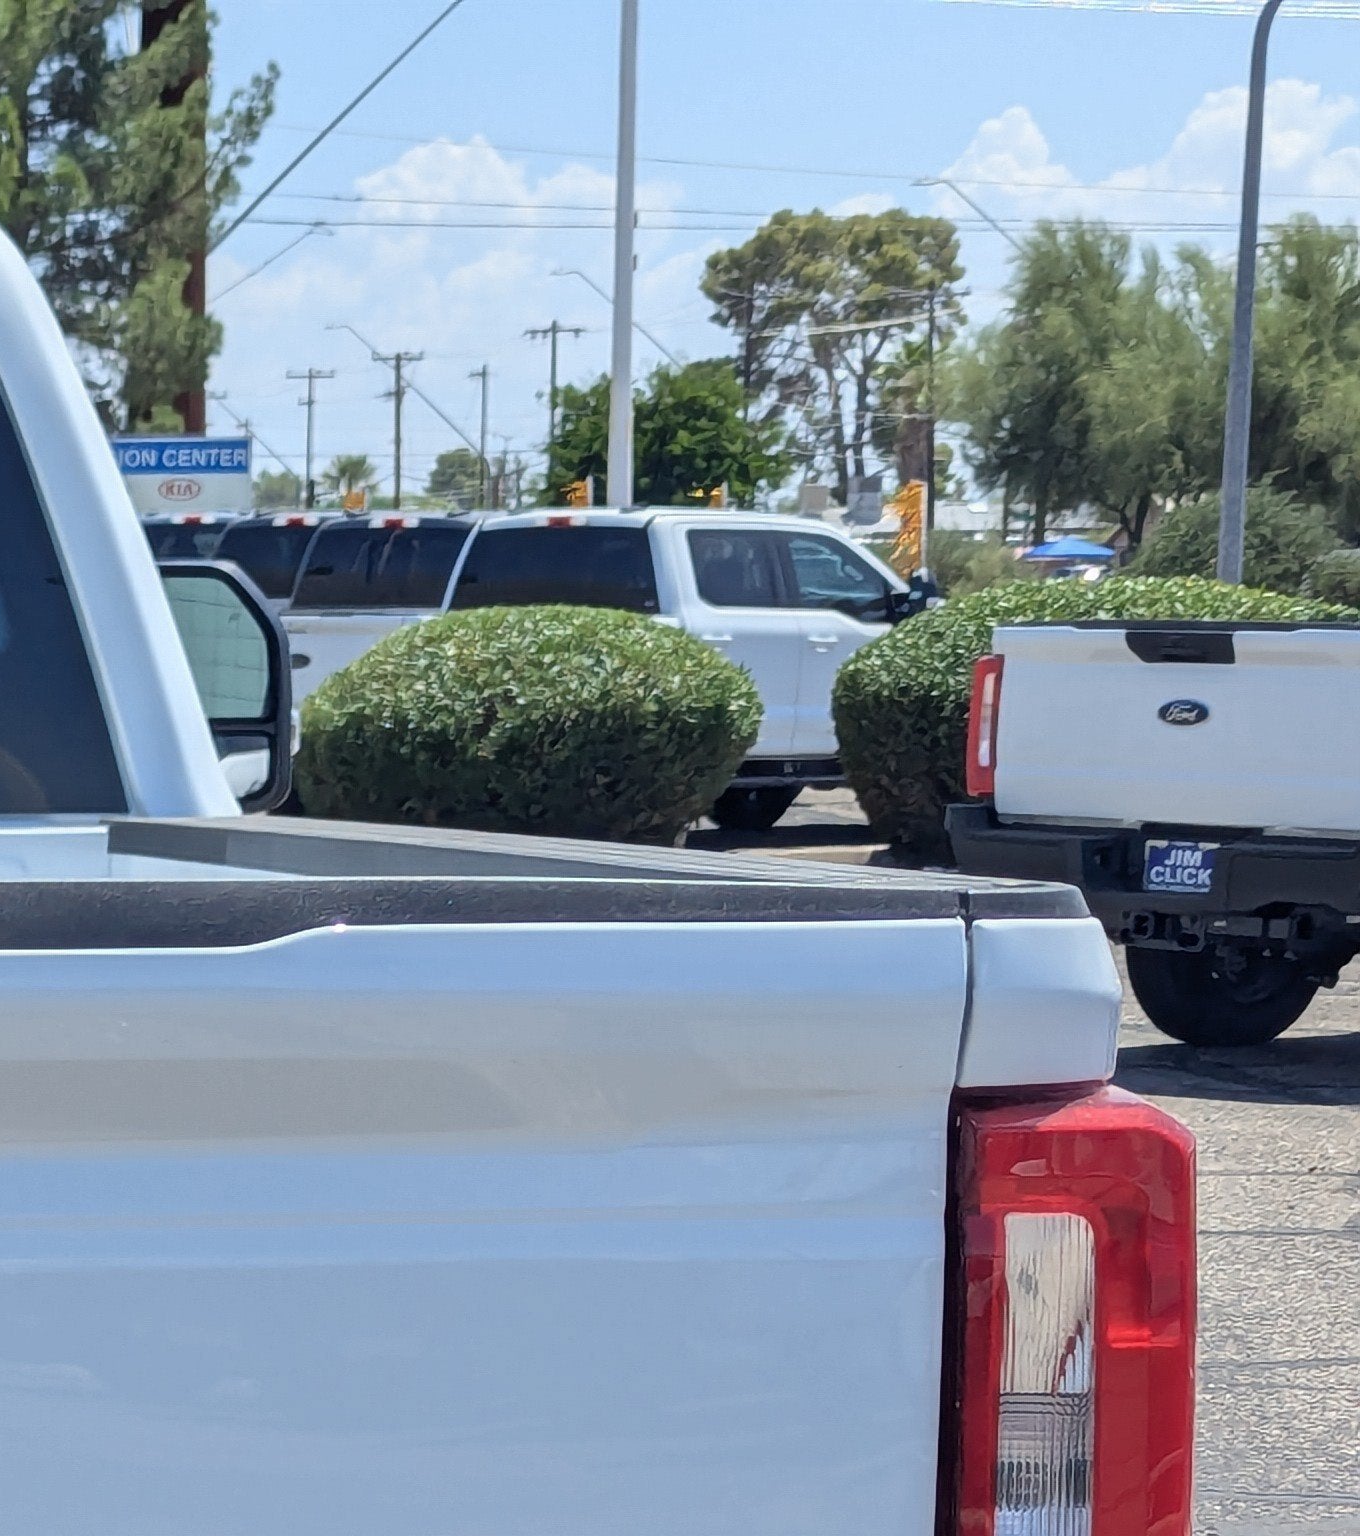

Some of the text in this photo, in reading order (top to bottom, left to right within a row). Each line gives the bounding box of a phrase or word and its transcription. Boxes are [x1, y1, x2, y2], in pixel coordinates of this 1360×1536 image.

[162, 448, 247, 467] CENTER
[165, 483, 194, 497] KIA
[1165, 704, 1200, 722] Ford
[1164, 849, 1203, 867] JIM
[1149, 865, 1214, 886] CLICK
